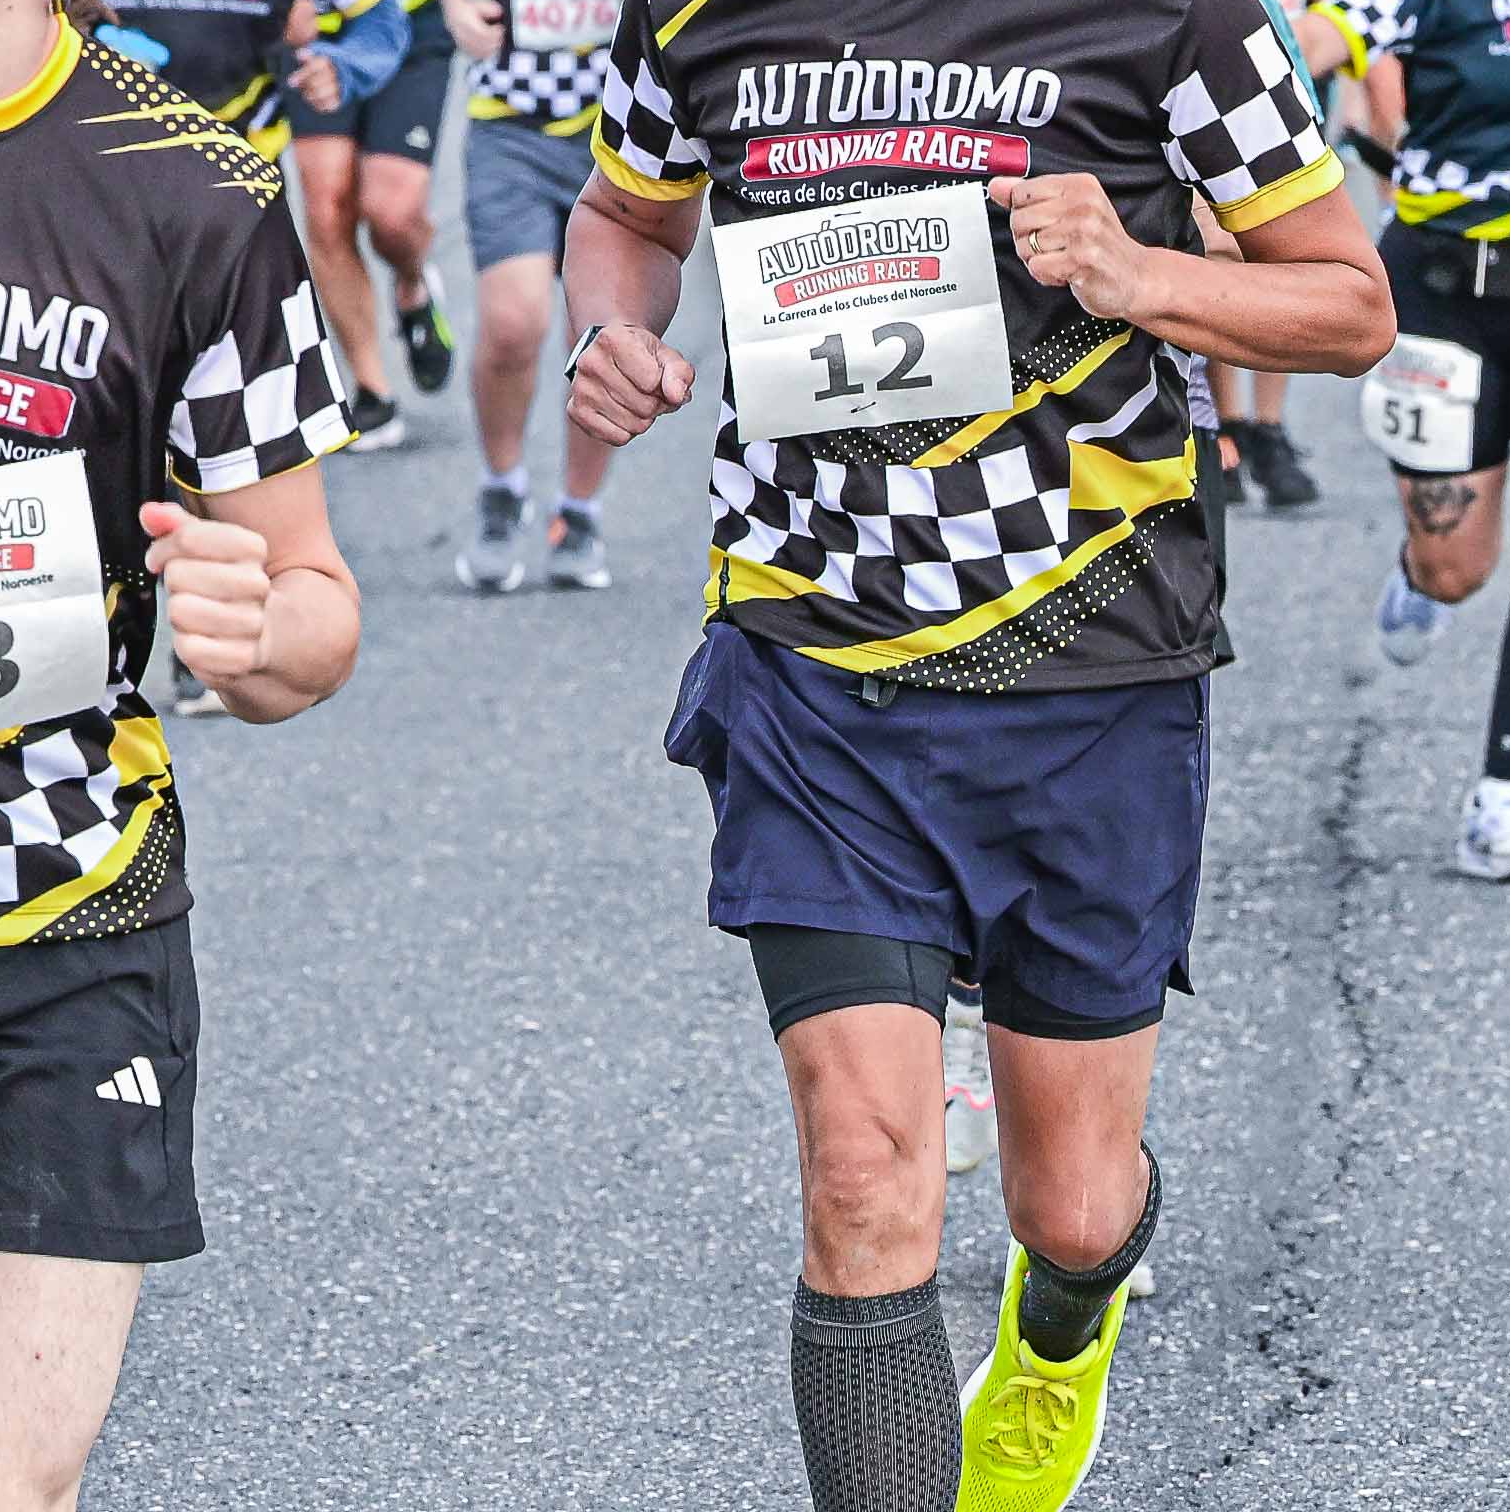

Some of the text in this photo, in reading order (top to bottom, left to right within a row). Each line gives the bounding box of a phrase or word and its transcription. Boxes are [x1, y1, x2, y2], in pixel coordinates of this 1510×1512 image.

[729, 42, 1062, 132] AUTÓDROMO
[768, 129, 993, 176] RUNNING RACE
[794, 183, 816, 203] de
[820, 181, 845, 202] los
[758, 217, 950, 284] AUTÓDROMO
[792, 260, 921, 300] RUNNING RACE
[763, 282, 958, 325] La Carrera de los Clubes del Noroeste
[809, 321, 933, 402] 12
[1381, 399, 1428, 444] 51
[0, 572, 54, 593] Noroeste
